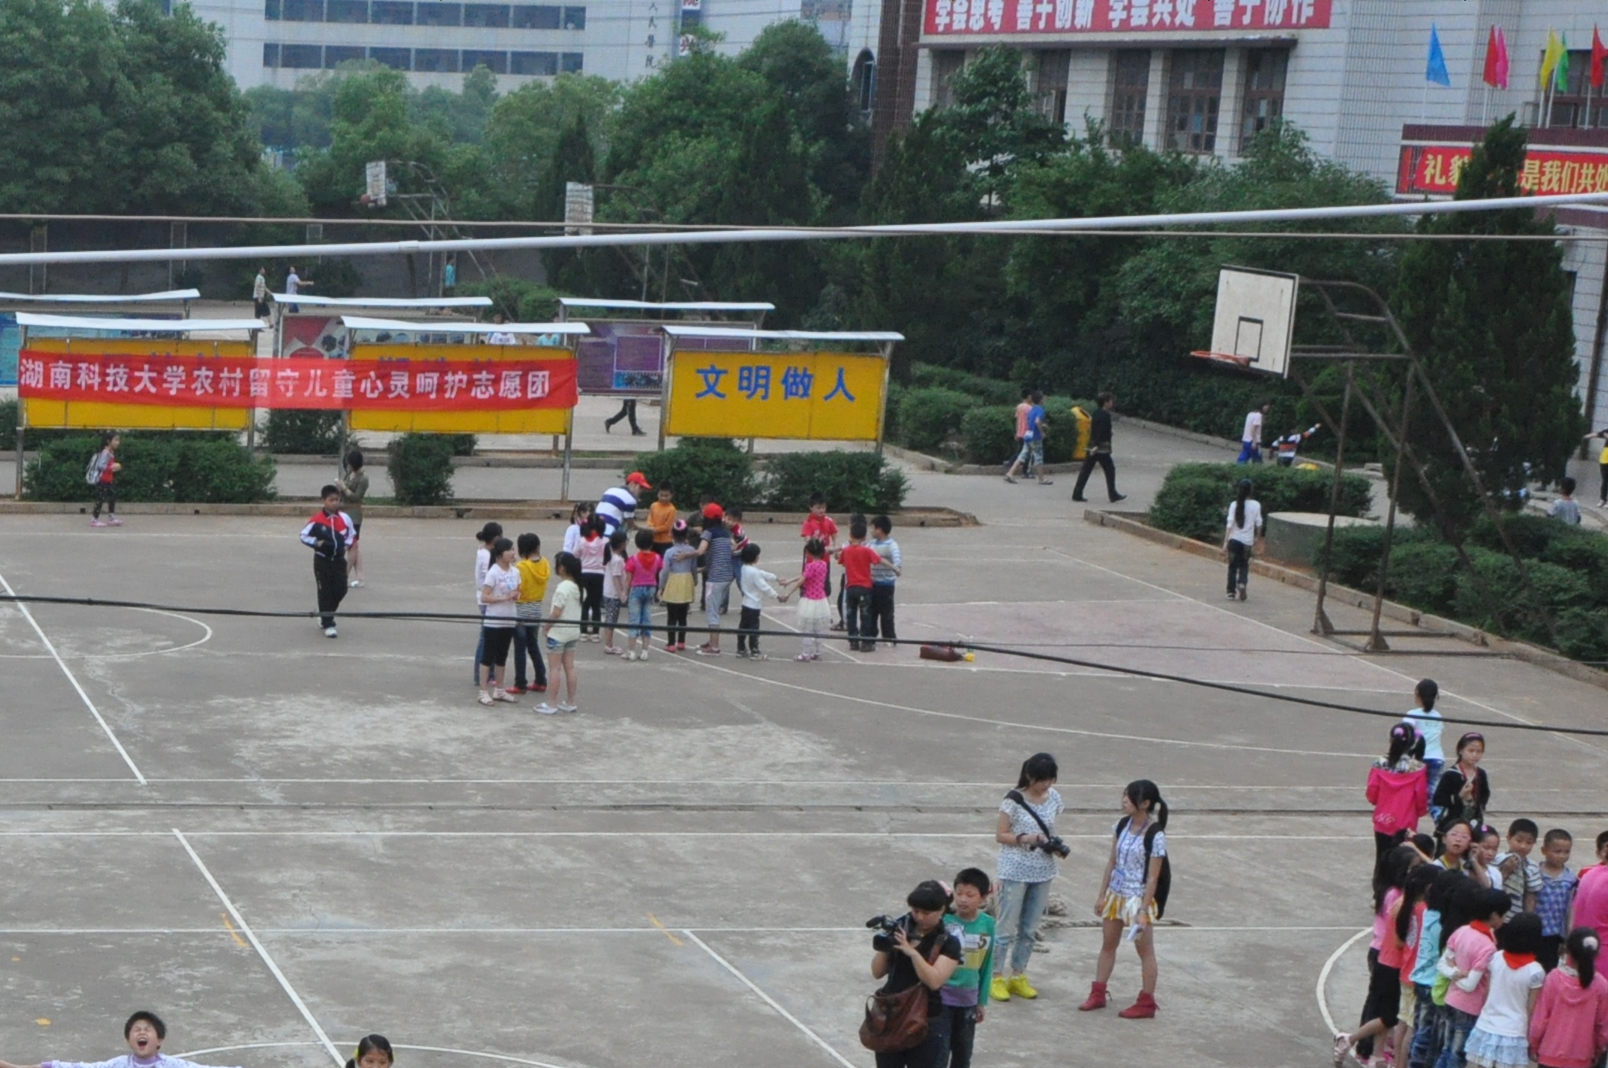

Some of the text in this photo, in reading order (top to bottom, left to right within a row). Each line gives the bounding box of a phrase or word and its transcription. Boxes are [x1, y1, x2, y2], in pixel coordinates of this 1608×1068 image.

[19, 358, 551, 399] 湖南科技大学农村留守儿童心灵呵护志愿团
[695, 364, 856, 403] 文明做人
